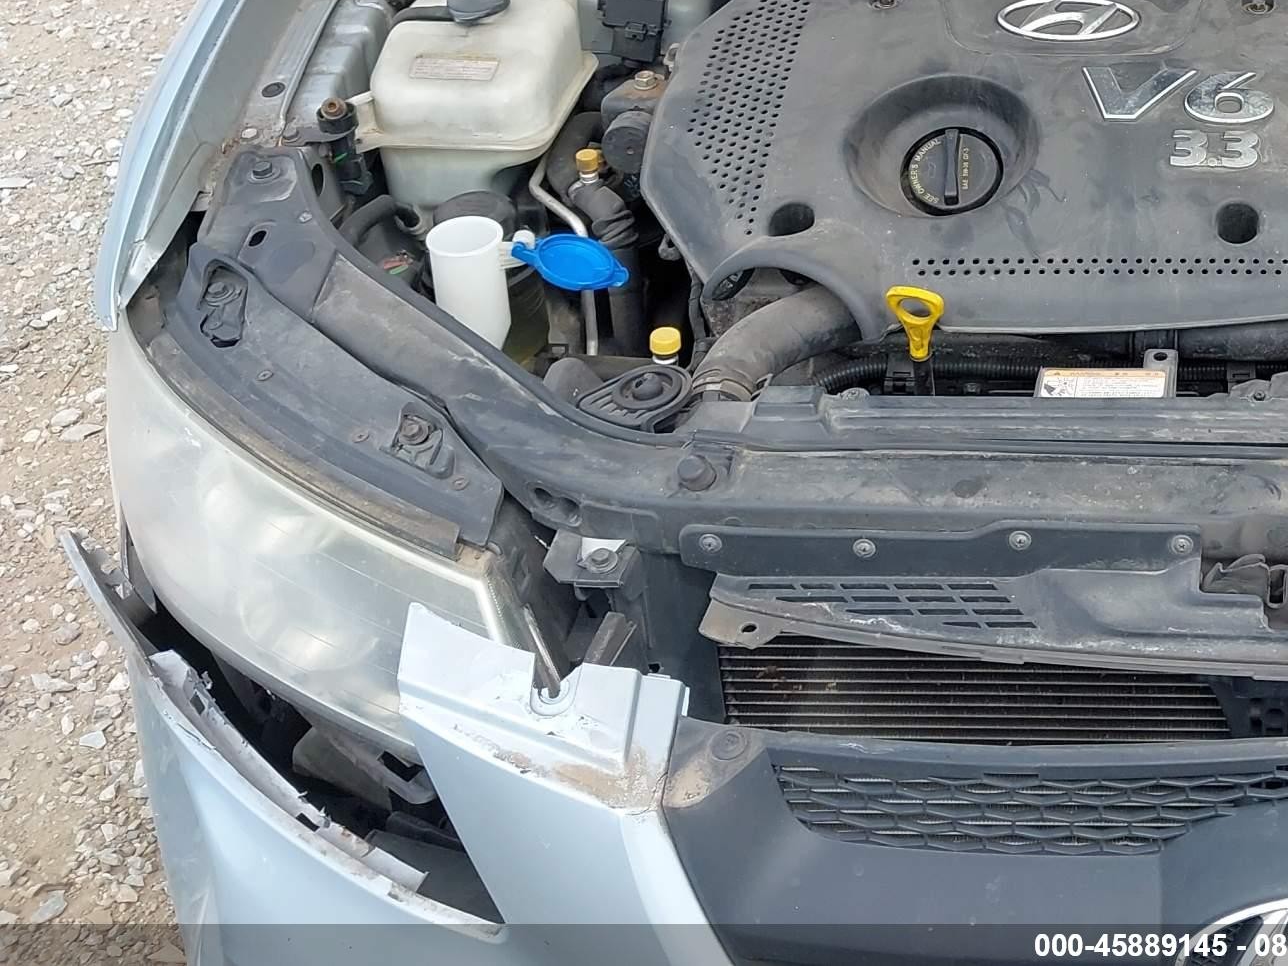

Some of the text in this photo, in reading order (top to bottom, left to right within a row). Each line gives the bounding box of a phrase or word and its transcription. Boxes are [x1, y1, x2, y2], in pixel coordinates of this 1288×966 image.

[1082, 66, 1274, 123] V6
[914, 138, 941, 162] MANUAL
[1170, 130, 1260, 168] 3.3
[922, 190, 940, 204] SEE
